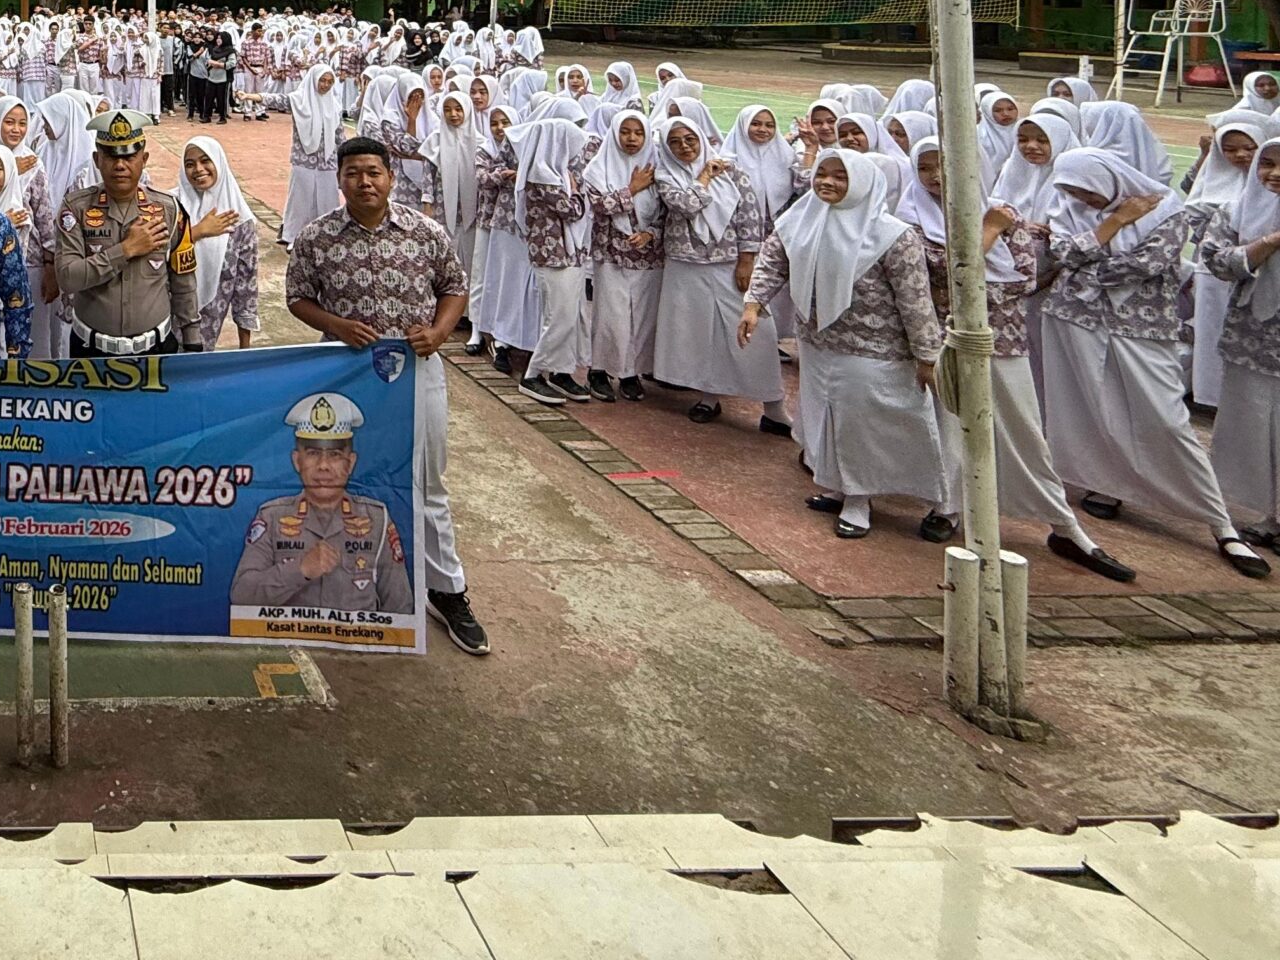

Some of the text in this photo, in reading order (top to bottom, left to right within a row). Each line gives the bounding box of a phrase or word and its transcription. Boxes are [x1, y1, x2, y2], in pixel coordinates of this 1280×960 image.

[8, 463, 149, 503] PALLAWA
[155, 466, 252, 507] 2026”
[4, 518, 84, 536] Februari
[89, 520, 131, 536] 2026
[345, 541, 372, 551] POLRI
[49, 556, 108, 583] Nyaman
[112, 557, 139, 581] dan
[143, 559, 202, 584] Selamat
[258, 607, 392, 624] AKP. MUH. ALI, S.Sos
[267, 622, 384, 640] Kasat Lantas Enrekang
